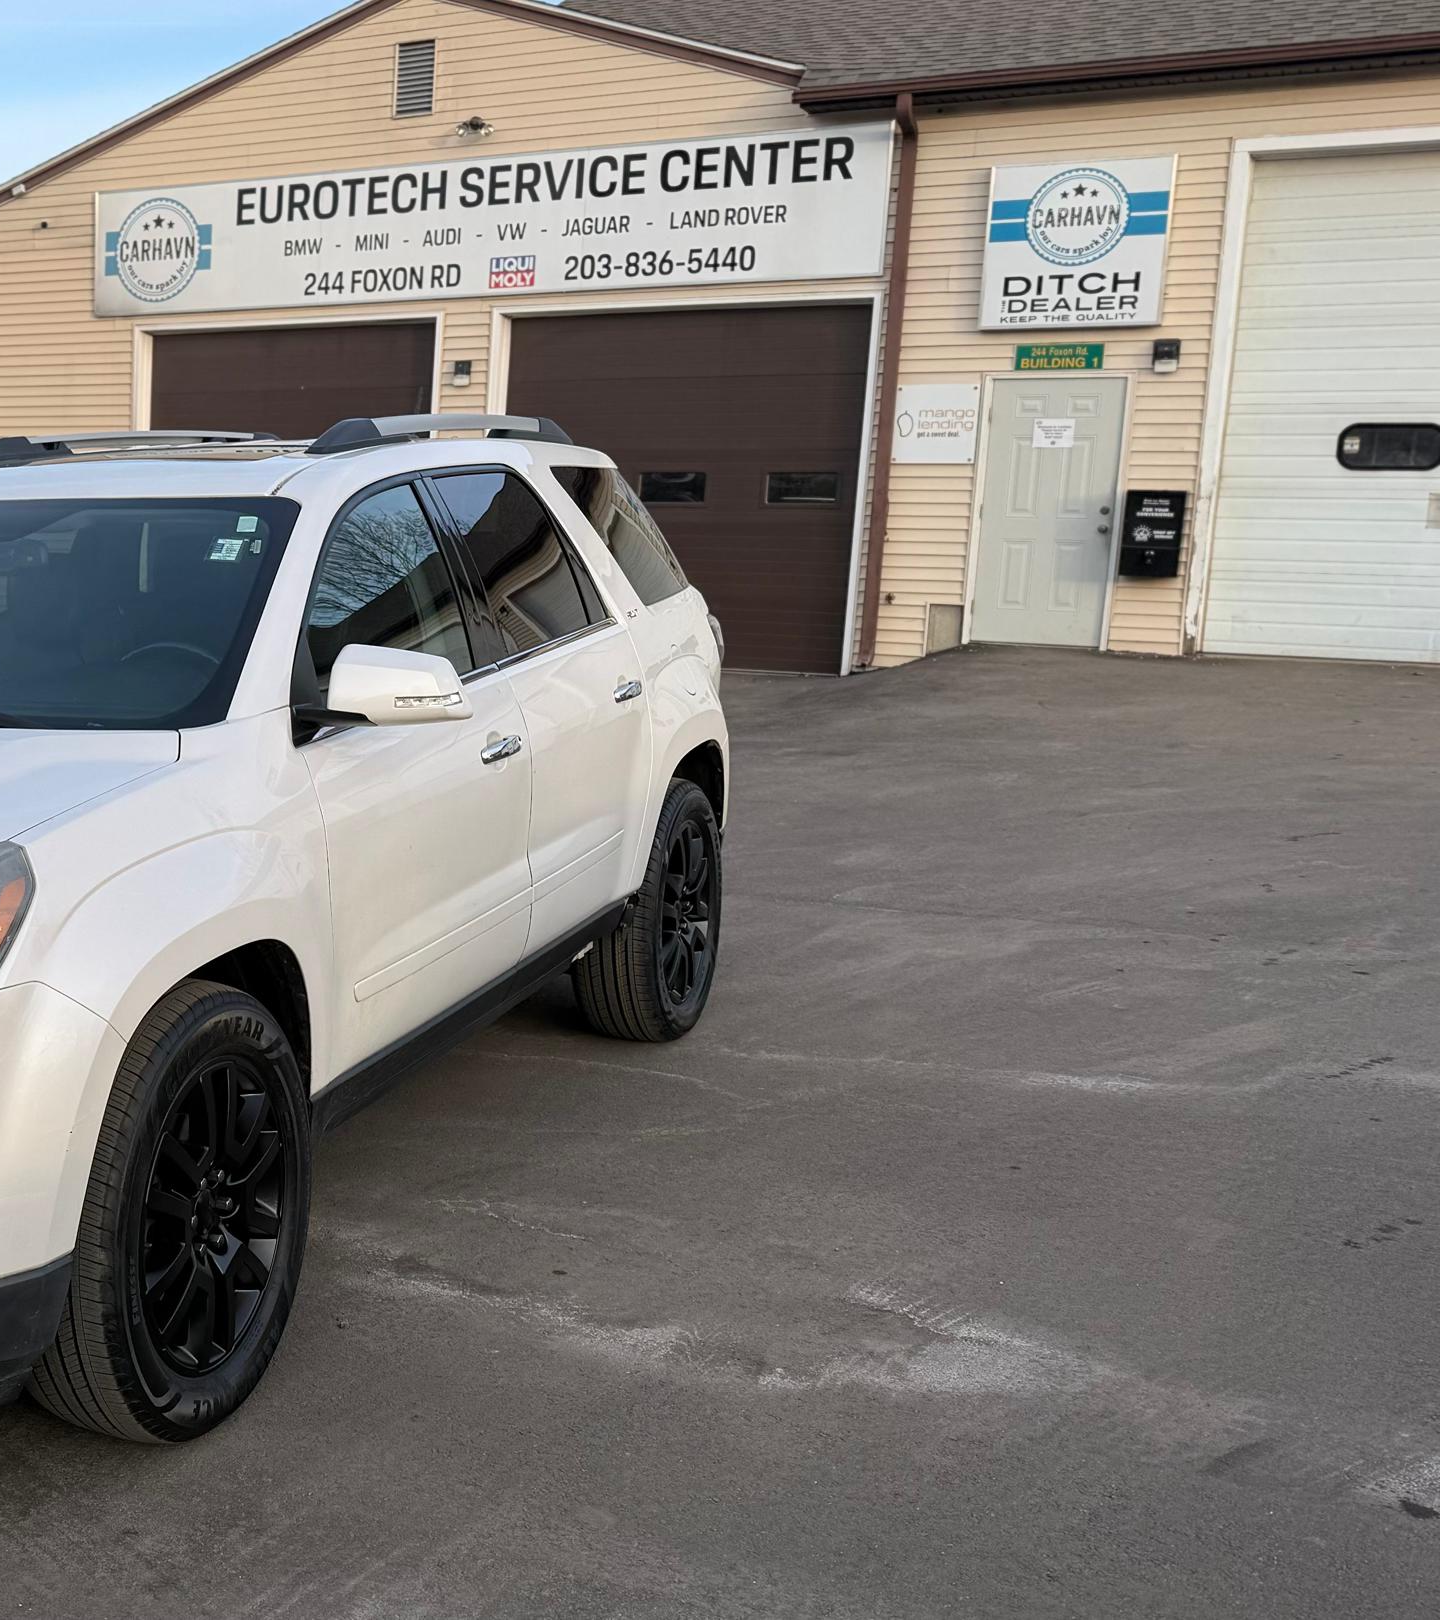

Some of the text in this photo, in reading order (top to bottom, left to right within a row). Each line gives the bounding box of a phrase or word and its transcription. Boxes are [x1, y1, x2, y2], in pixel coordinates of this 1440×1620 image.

[236, 136, 854, 226] EUROTECH SERVICE CENTER
[1032, 205, 1120, 229] CARHAVN
[285, 238, 322, 256] BMW
[355, 233, 389, 251] MINI
[423, 228, 461, 246] AUDI
[497, 222, 526, 240] VW
[562, 215, 630, 236] JAGUAR
[670, 209, 719, 229] LAND
[724, 205, 787, 226] ROVER
[1040, 226, 1113, 255] our cars spark joy
[120, 236, 194, 262] CARHAVN
[492, 256, 534, 272] LIQUI
[564, 245, 755, 280] 203-836-5440
[128, 260, 188, 291] our cars spark joy
[304, 264, 461, 296] 244 FOXON RD
[490, 273, 534, 287] MOLY
[1003, 272, 1141, 297] DITCH
[1008, 295, 1138, 313] DEALER
[1043, 314, 1070, 322] THE
[1076, 313, 1136, 321] QUALITY
[1021, 356, 1098, 368] BUILDING 1
[1031, 347, 1046, 356] 244
[918, 420, 974, 431] lending
[919, 409, 975, 420] mango
